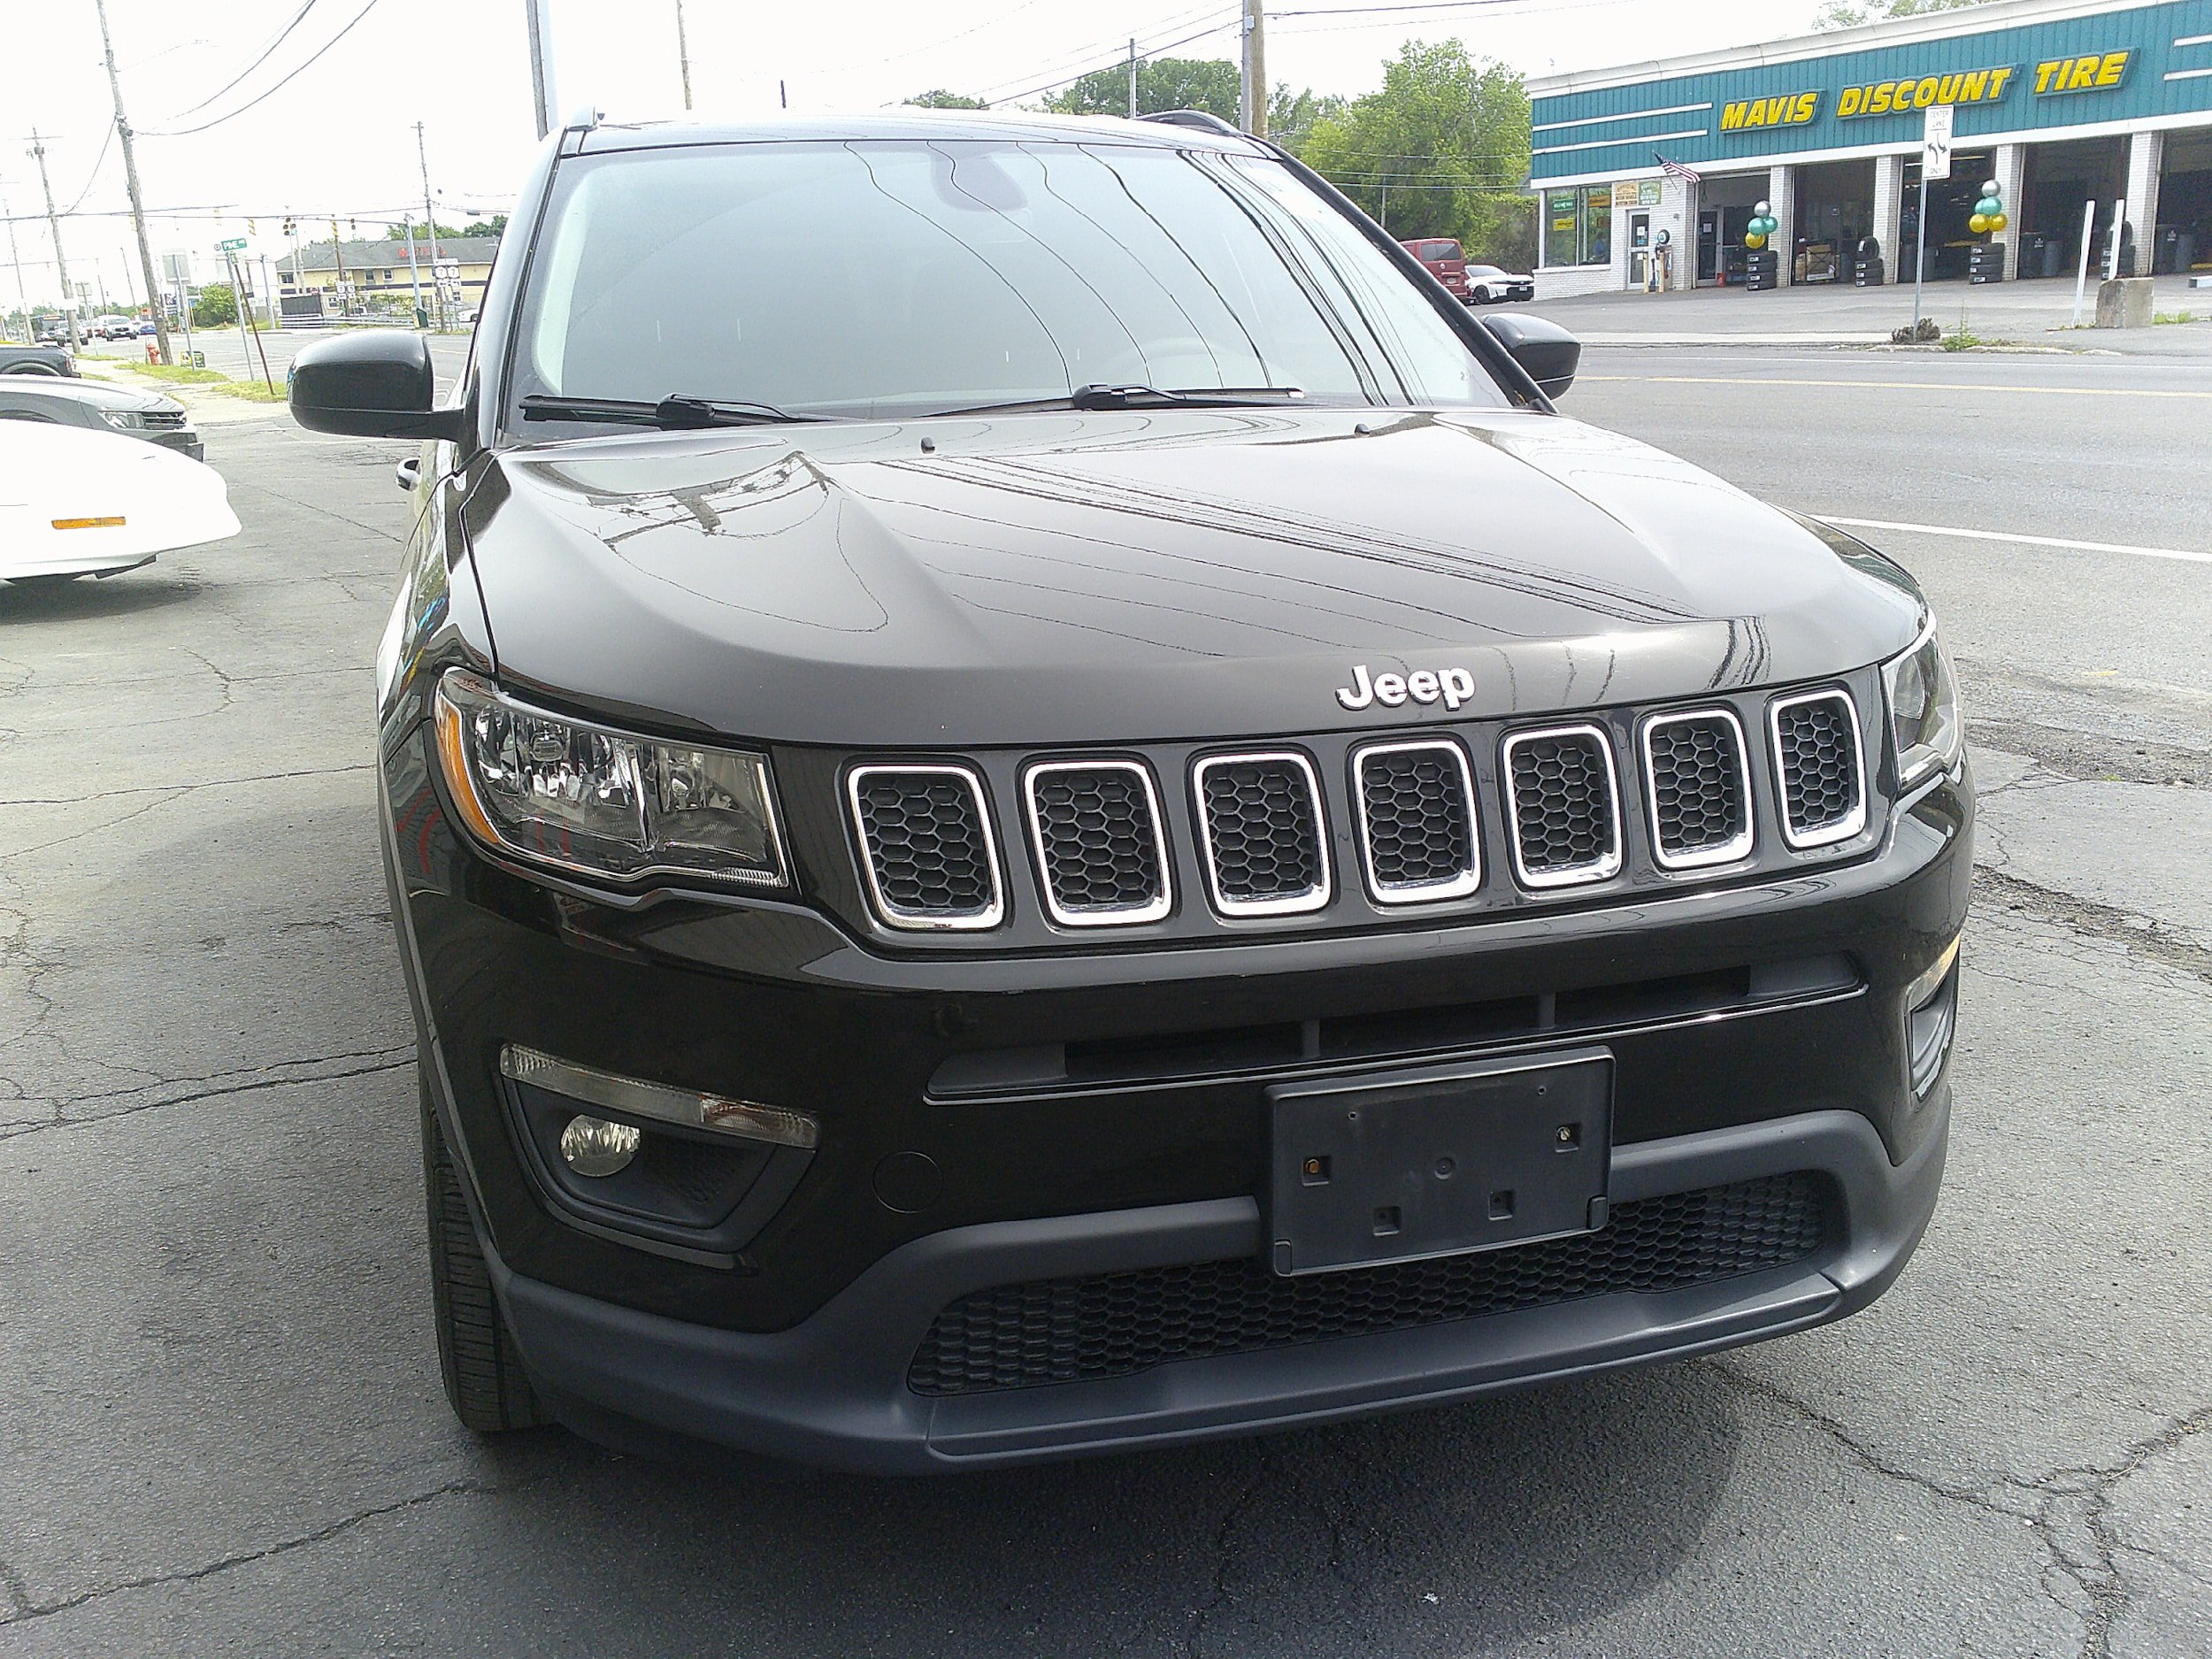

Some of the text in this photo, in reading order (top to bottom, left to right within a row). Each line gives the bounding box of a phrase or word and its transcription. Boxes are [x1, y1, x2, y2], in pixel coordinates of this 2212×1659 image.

[1720, 50, 2130, 132] MAVIS DISCOUNT TIRE
[1335, 664, 1475, 711] Jeep
